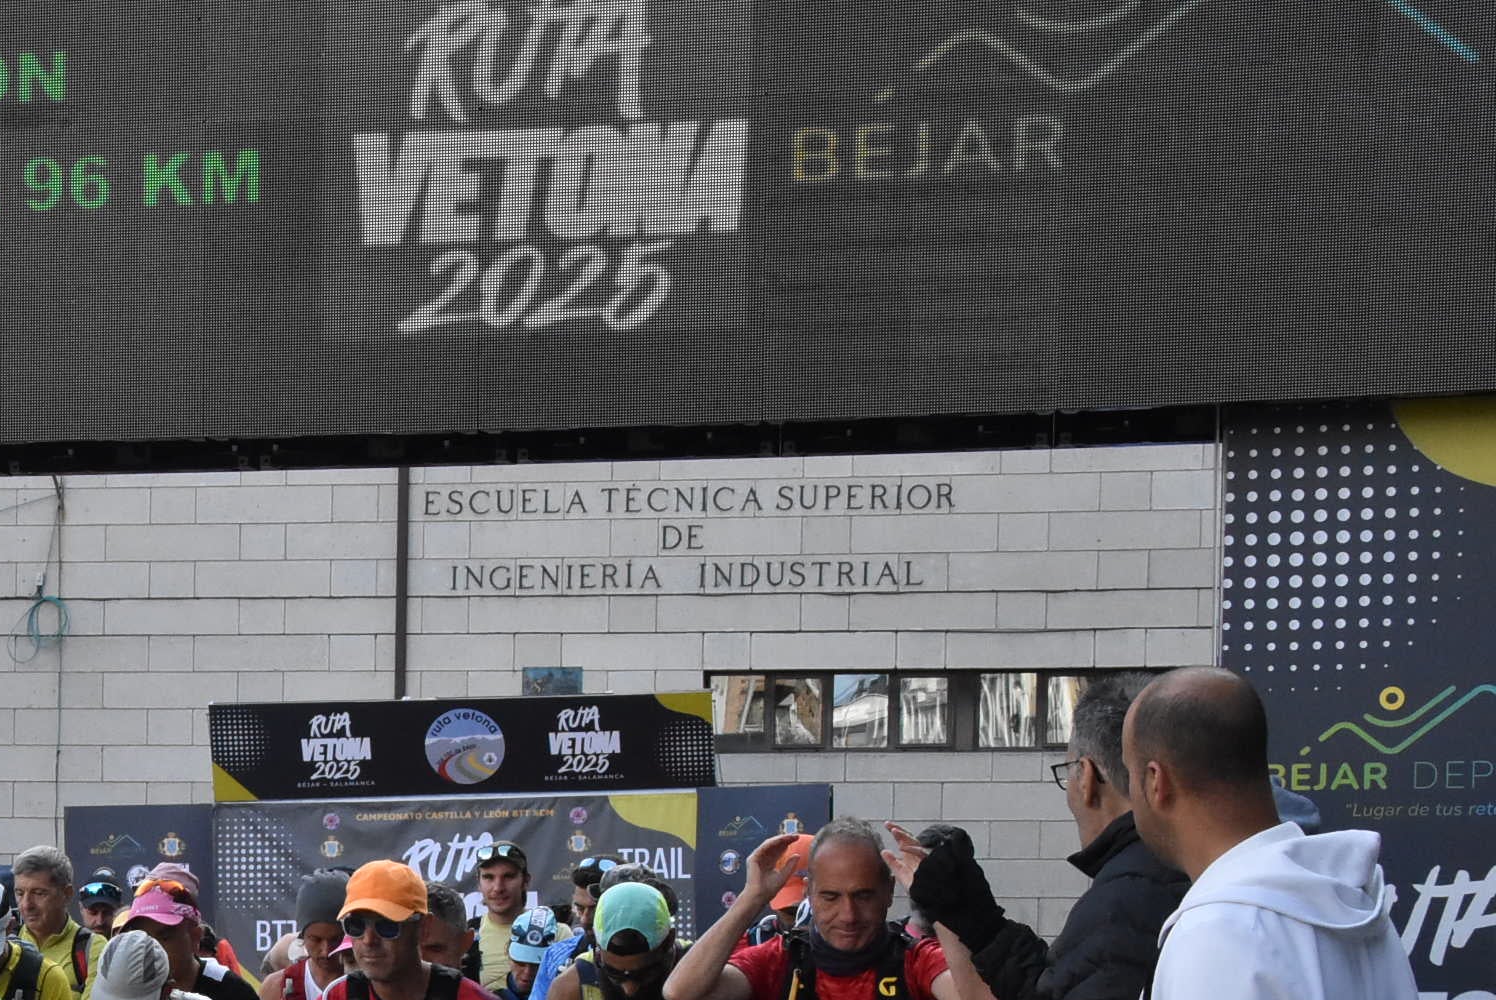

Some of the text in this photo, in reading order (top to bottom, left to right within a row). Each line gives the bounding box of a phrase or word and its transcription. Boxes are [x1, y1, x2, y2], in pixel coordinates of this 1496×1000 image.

[406, 0, 653, 123] RUTA
[790, 88, 1067, 184] BÉJAR
[24, 155, 110, 211] 96
[141, 148, 260, 206] KM
[352, 118, 748, 245] VETONA
[397, 240, 675, 331] 2025
[423, 482, 955, 517] ESCUELA TÉCNICA SUPERIOR
[660, 523, 704, 551] DE
[450, 560, 924, 592] INGENIERÍA INDUSTRIAL
[309, 712, 351, 738] RUTA
[431, 709, 498, 737] ruta vetona
[557, 705, 600, 731] RUTA
[301, 737, 372, 761] VETONA
[548, 730, 621, 755] VETONA
[310, 760, 360, 780] 2025
[558, 754, 609, 773] 2025
[356, 812, 423, 822] CAMPEONATO
[425, 810, 472, 820] CASTILLA
[1408, 802, 1429, 816] de
[1435, 803, 1464, 816] tus
[1469, 802, 1496, 816] ret
